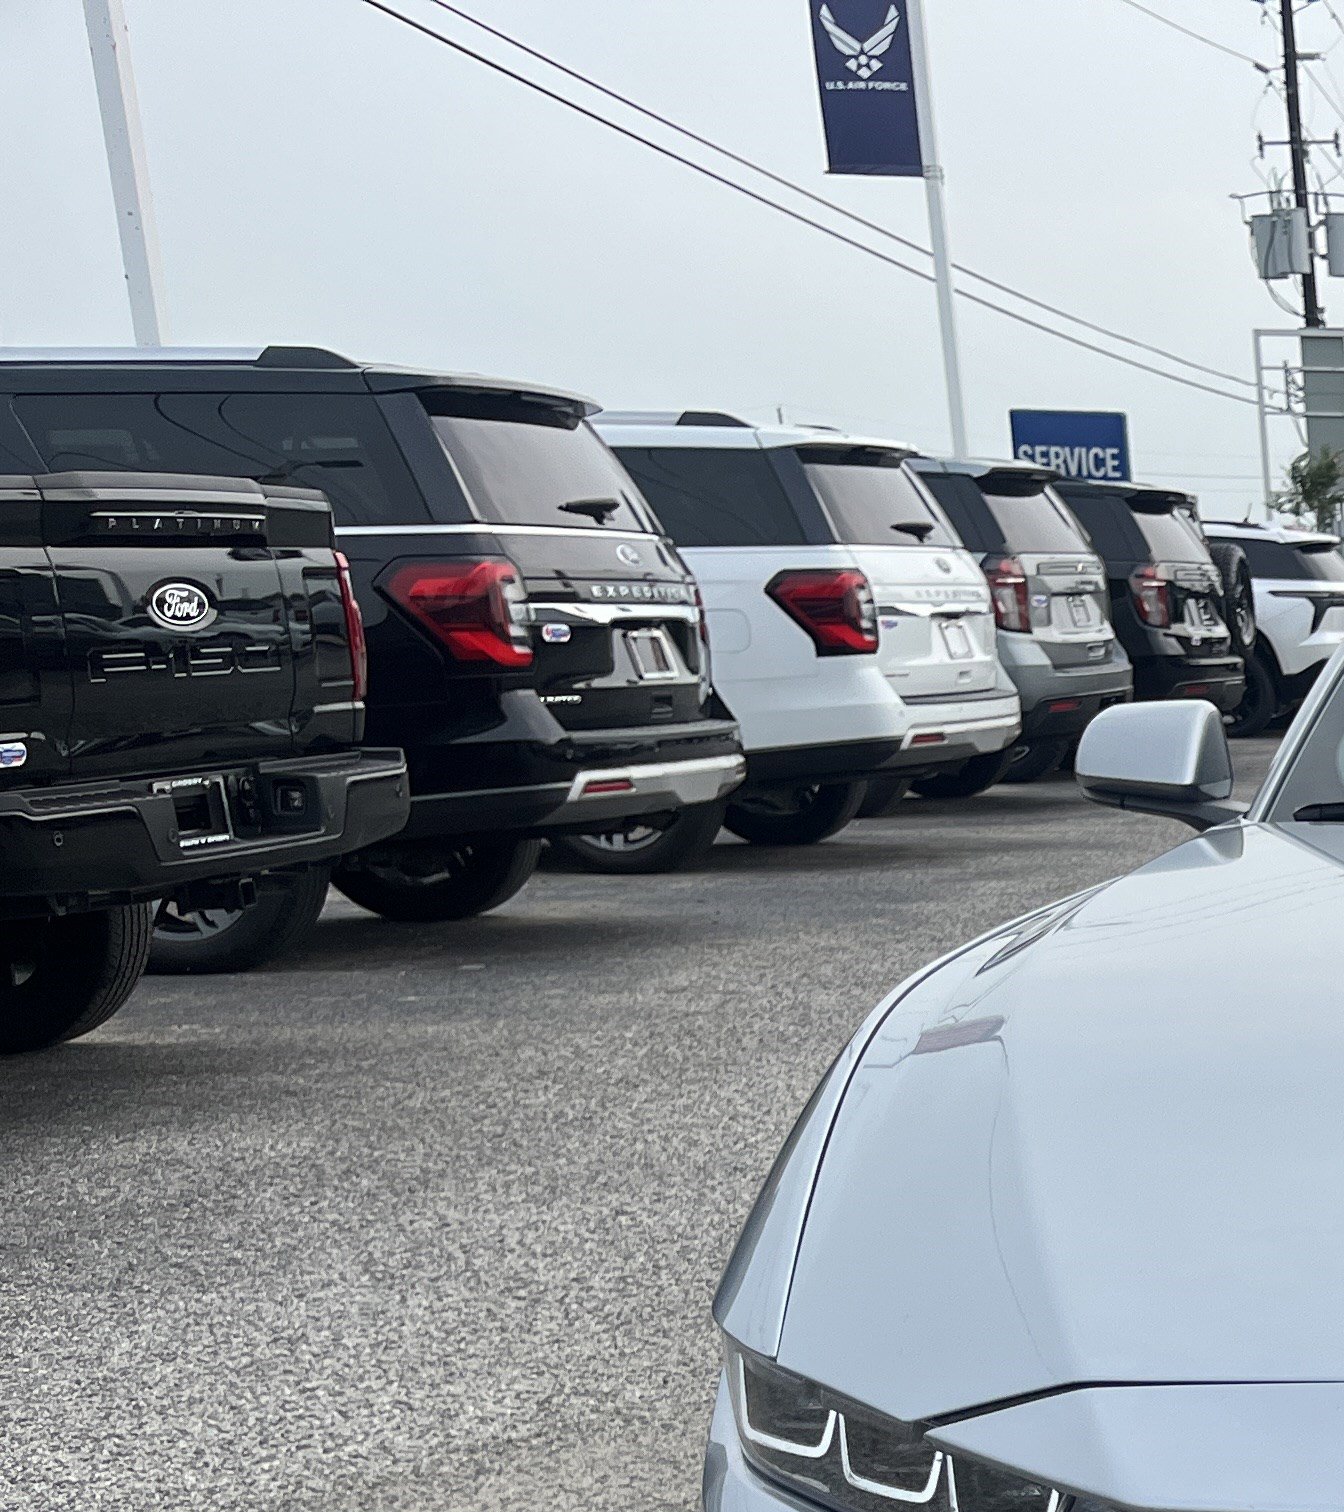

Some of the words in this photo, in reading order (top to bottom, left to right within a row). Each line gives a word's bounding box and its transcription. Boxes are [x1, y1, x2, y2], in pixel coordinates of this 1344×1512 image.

[847, 81, 867, 90] AIR
[868, 81, 909, 92] FORCE
[1017, 443, 1123, 479] SERVICE
[107, 517, 261, 531] PLATINUM
[163, 588, 200, 618] Ford
